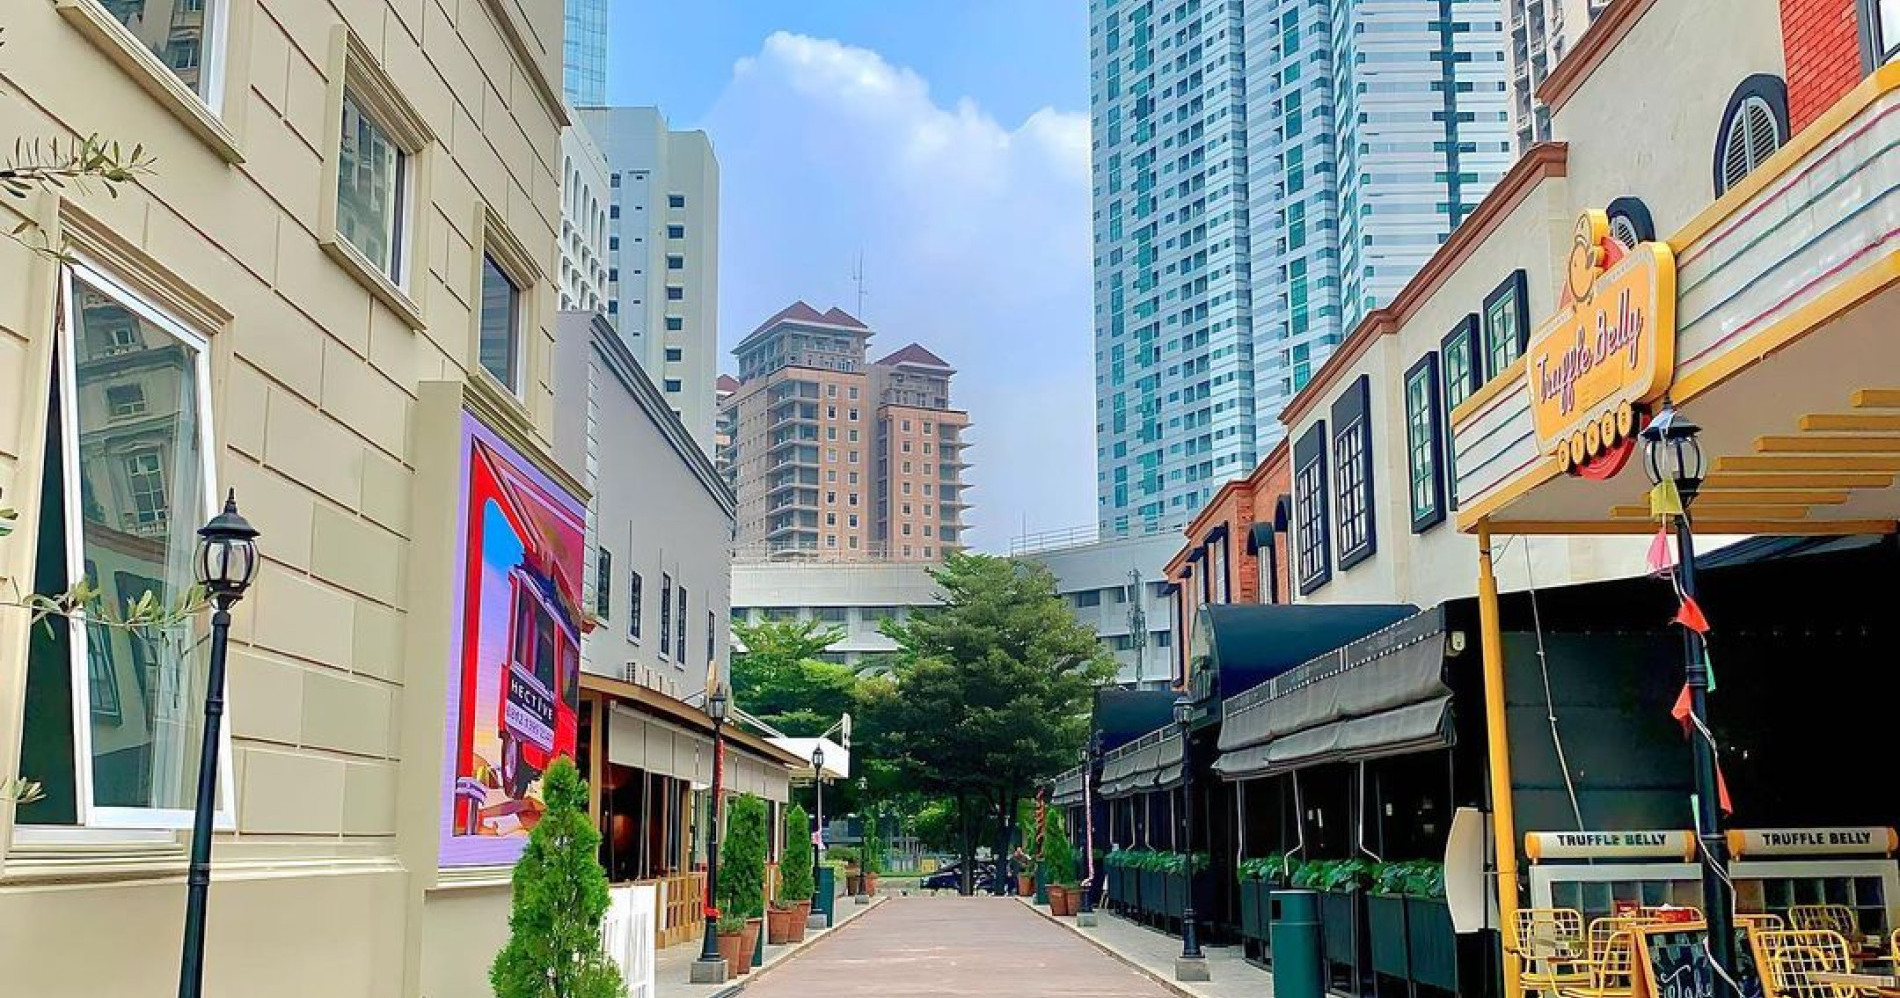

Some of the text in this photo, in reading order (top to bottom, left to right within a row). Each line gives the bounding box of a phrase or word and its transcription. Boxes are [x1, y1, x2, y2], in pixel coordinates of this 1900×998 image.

[1537, 287, 1644, 416] Truffle Belly
[1557, 833, 1667, 846] TRUFFLE BELLY
[1763, 832, 1871, 846] TRUFFLE BELLY
